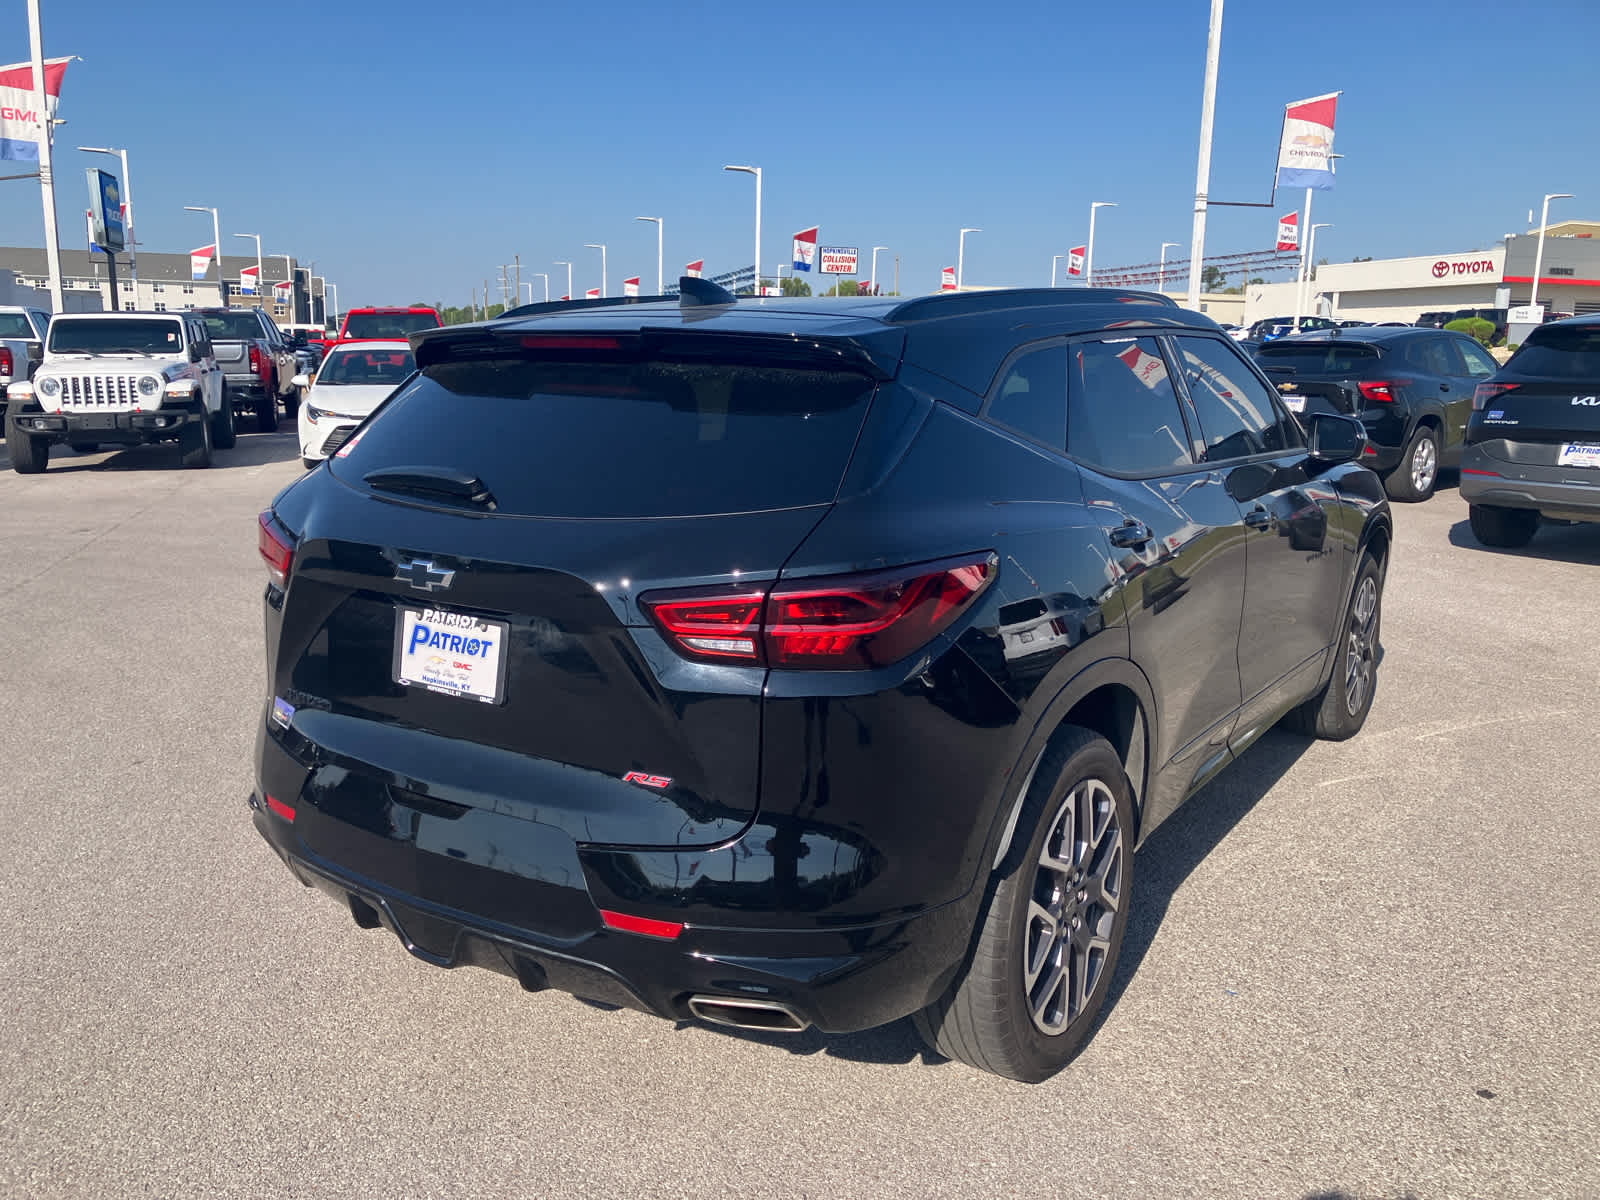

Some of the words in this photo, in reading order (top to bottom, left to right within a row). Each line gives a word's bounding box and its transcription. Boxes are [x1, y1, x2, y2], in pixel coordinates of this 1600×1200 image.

[826, 264, 852, 273] CENTER
[1452, 260, 1494, 275] TOYOTA
[1571, 396, 1600, 407] KI
[1565, 446, 1600, 456] PATRIO
[423, 609, 478, 629] PATRIOT
[408, 624, 492, 657] PATRIOT
[453, 660, 473, 671] GMC
[422, 674, 460, 690] Hopkinsville,
[461, 683, 471, 691] KY
[622, 771, 672, 788] RS
